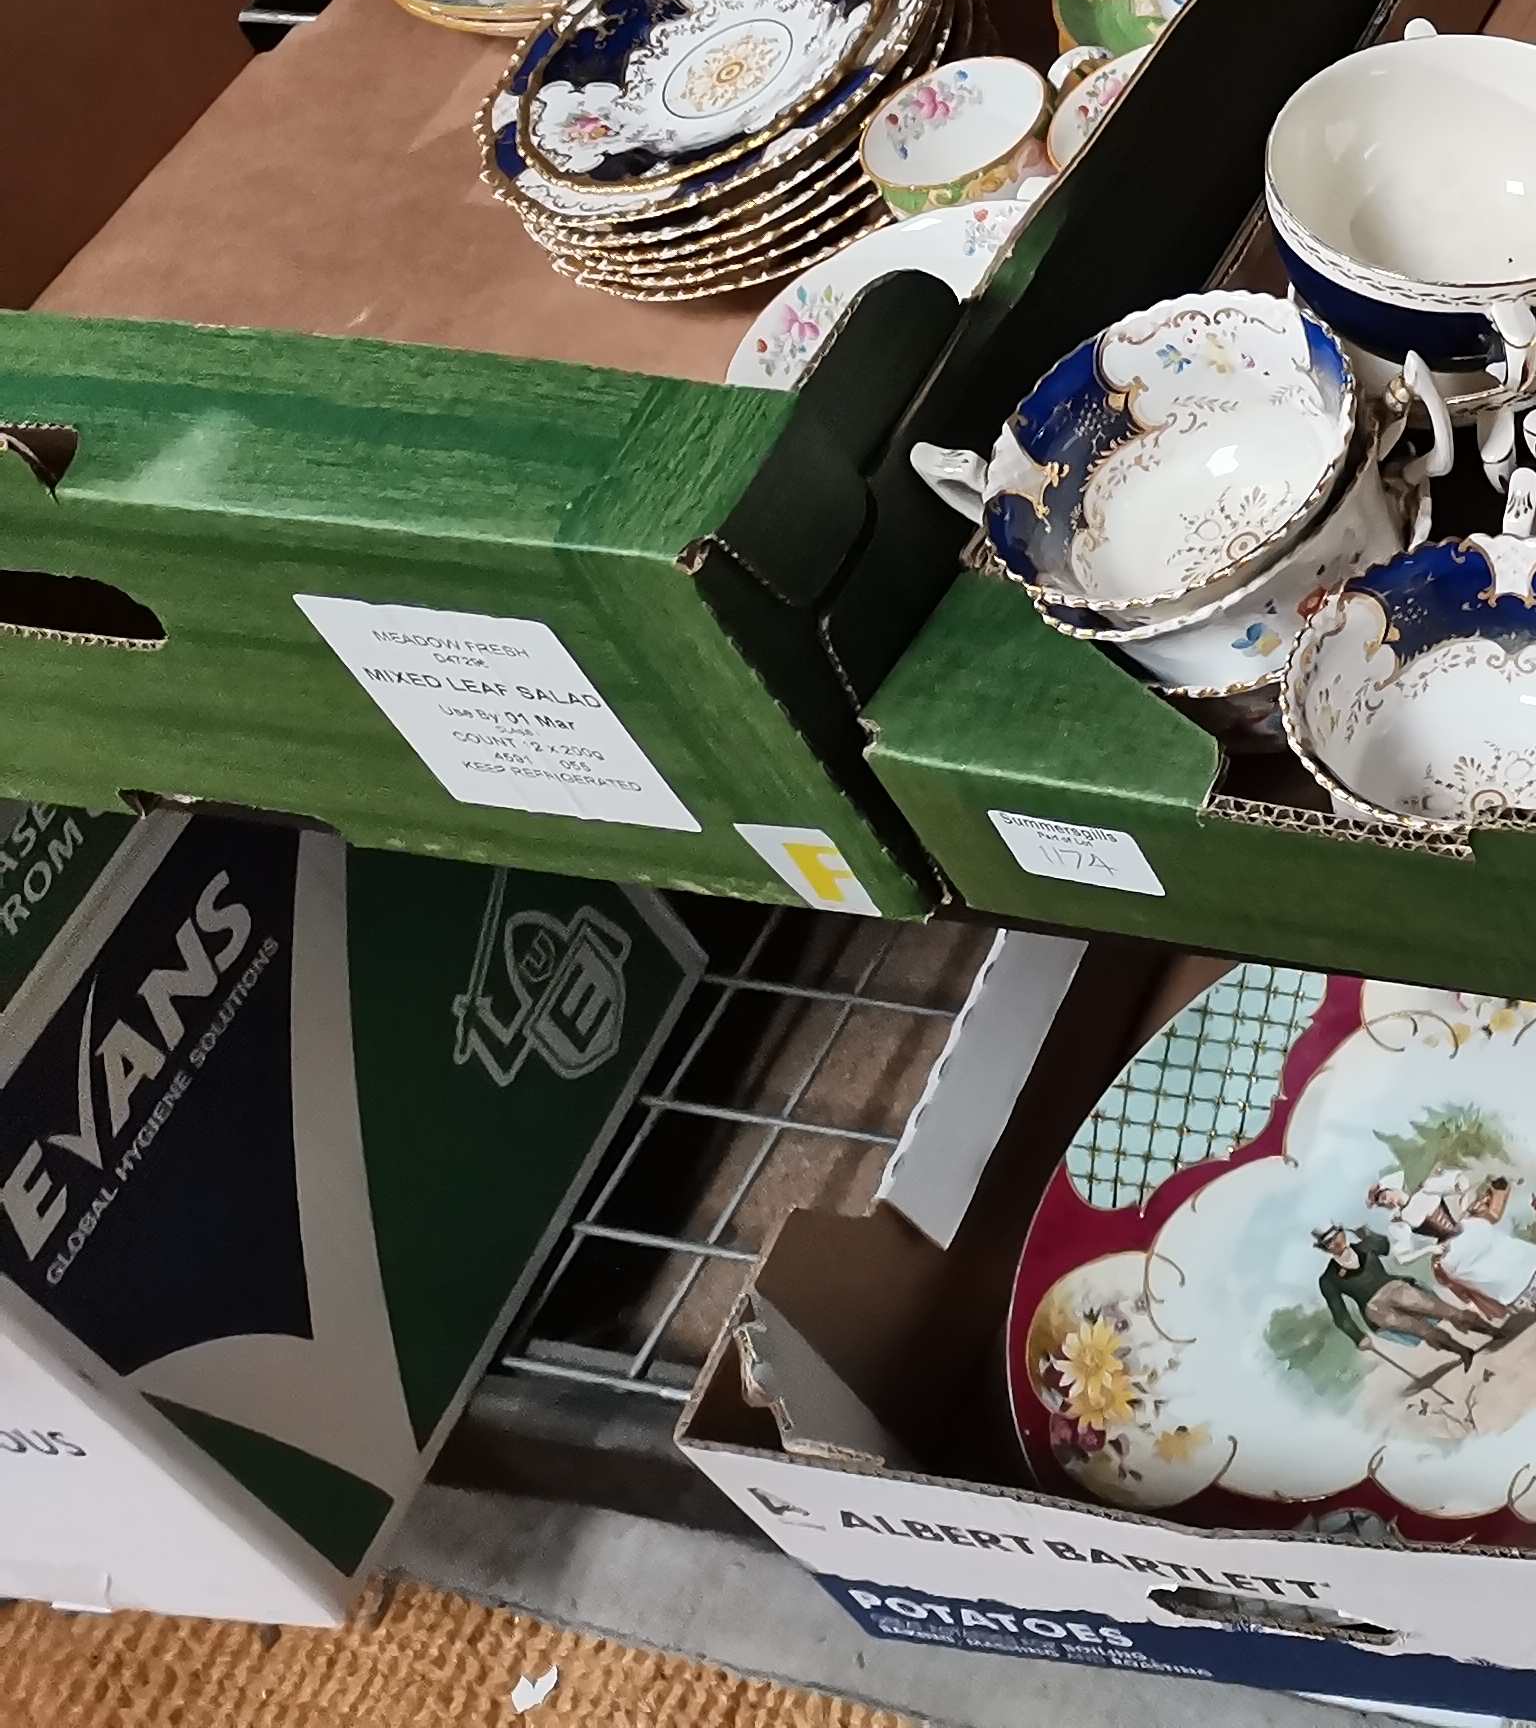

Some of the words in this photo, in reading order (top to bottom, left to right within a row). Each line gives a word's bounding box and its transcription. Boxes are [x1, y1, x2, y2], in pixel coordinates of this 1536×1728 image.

[371, 629, 461, 652] MEADOW
[465, 640, 531, 659] FRESH
[362, 666, 442, 689] MIXED
[446, 676, 509, 697] LEAF
[516, 685, 603, 709] SALAD
[438, 703, 474, 720] Use
[504, 710, 531, 726] 01
[533, 714, 576, 731] Mar
[452, 729, 518, 749] COUNT
[510, 765, 643, 793] REFRIGERATED
[999, 812, 1118, 843] Summersgills
[781, 842, 852, 902] F
[1038, 845, 1119, 876] 1174
[1, 869, 252, 1262] EVANS
[46, 1187, 120, 1285] GLOBAL
[115, 1070, 194, 1183] HYGIENE
[189, 936, 279, 1069] SOLUTIONS
[840, 1510, 1035, 1555] ALBERT
[1042, 1538, 1321, 1600] BARTLETT
[847, 1588, 1134, 1648] POTATOES
